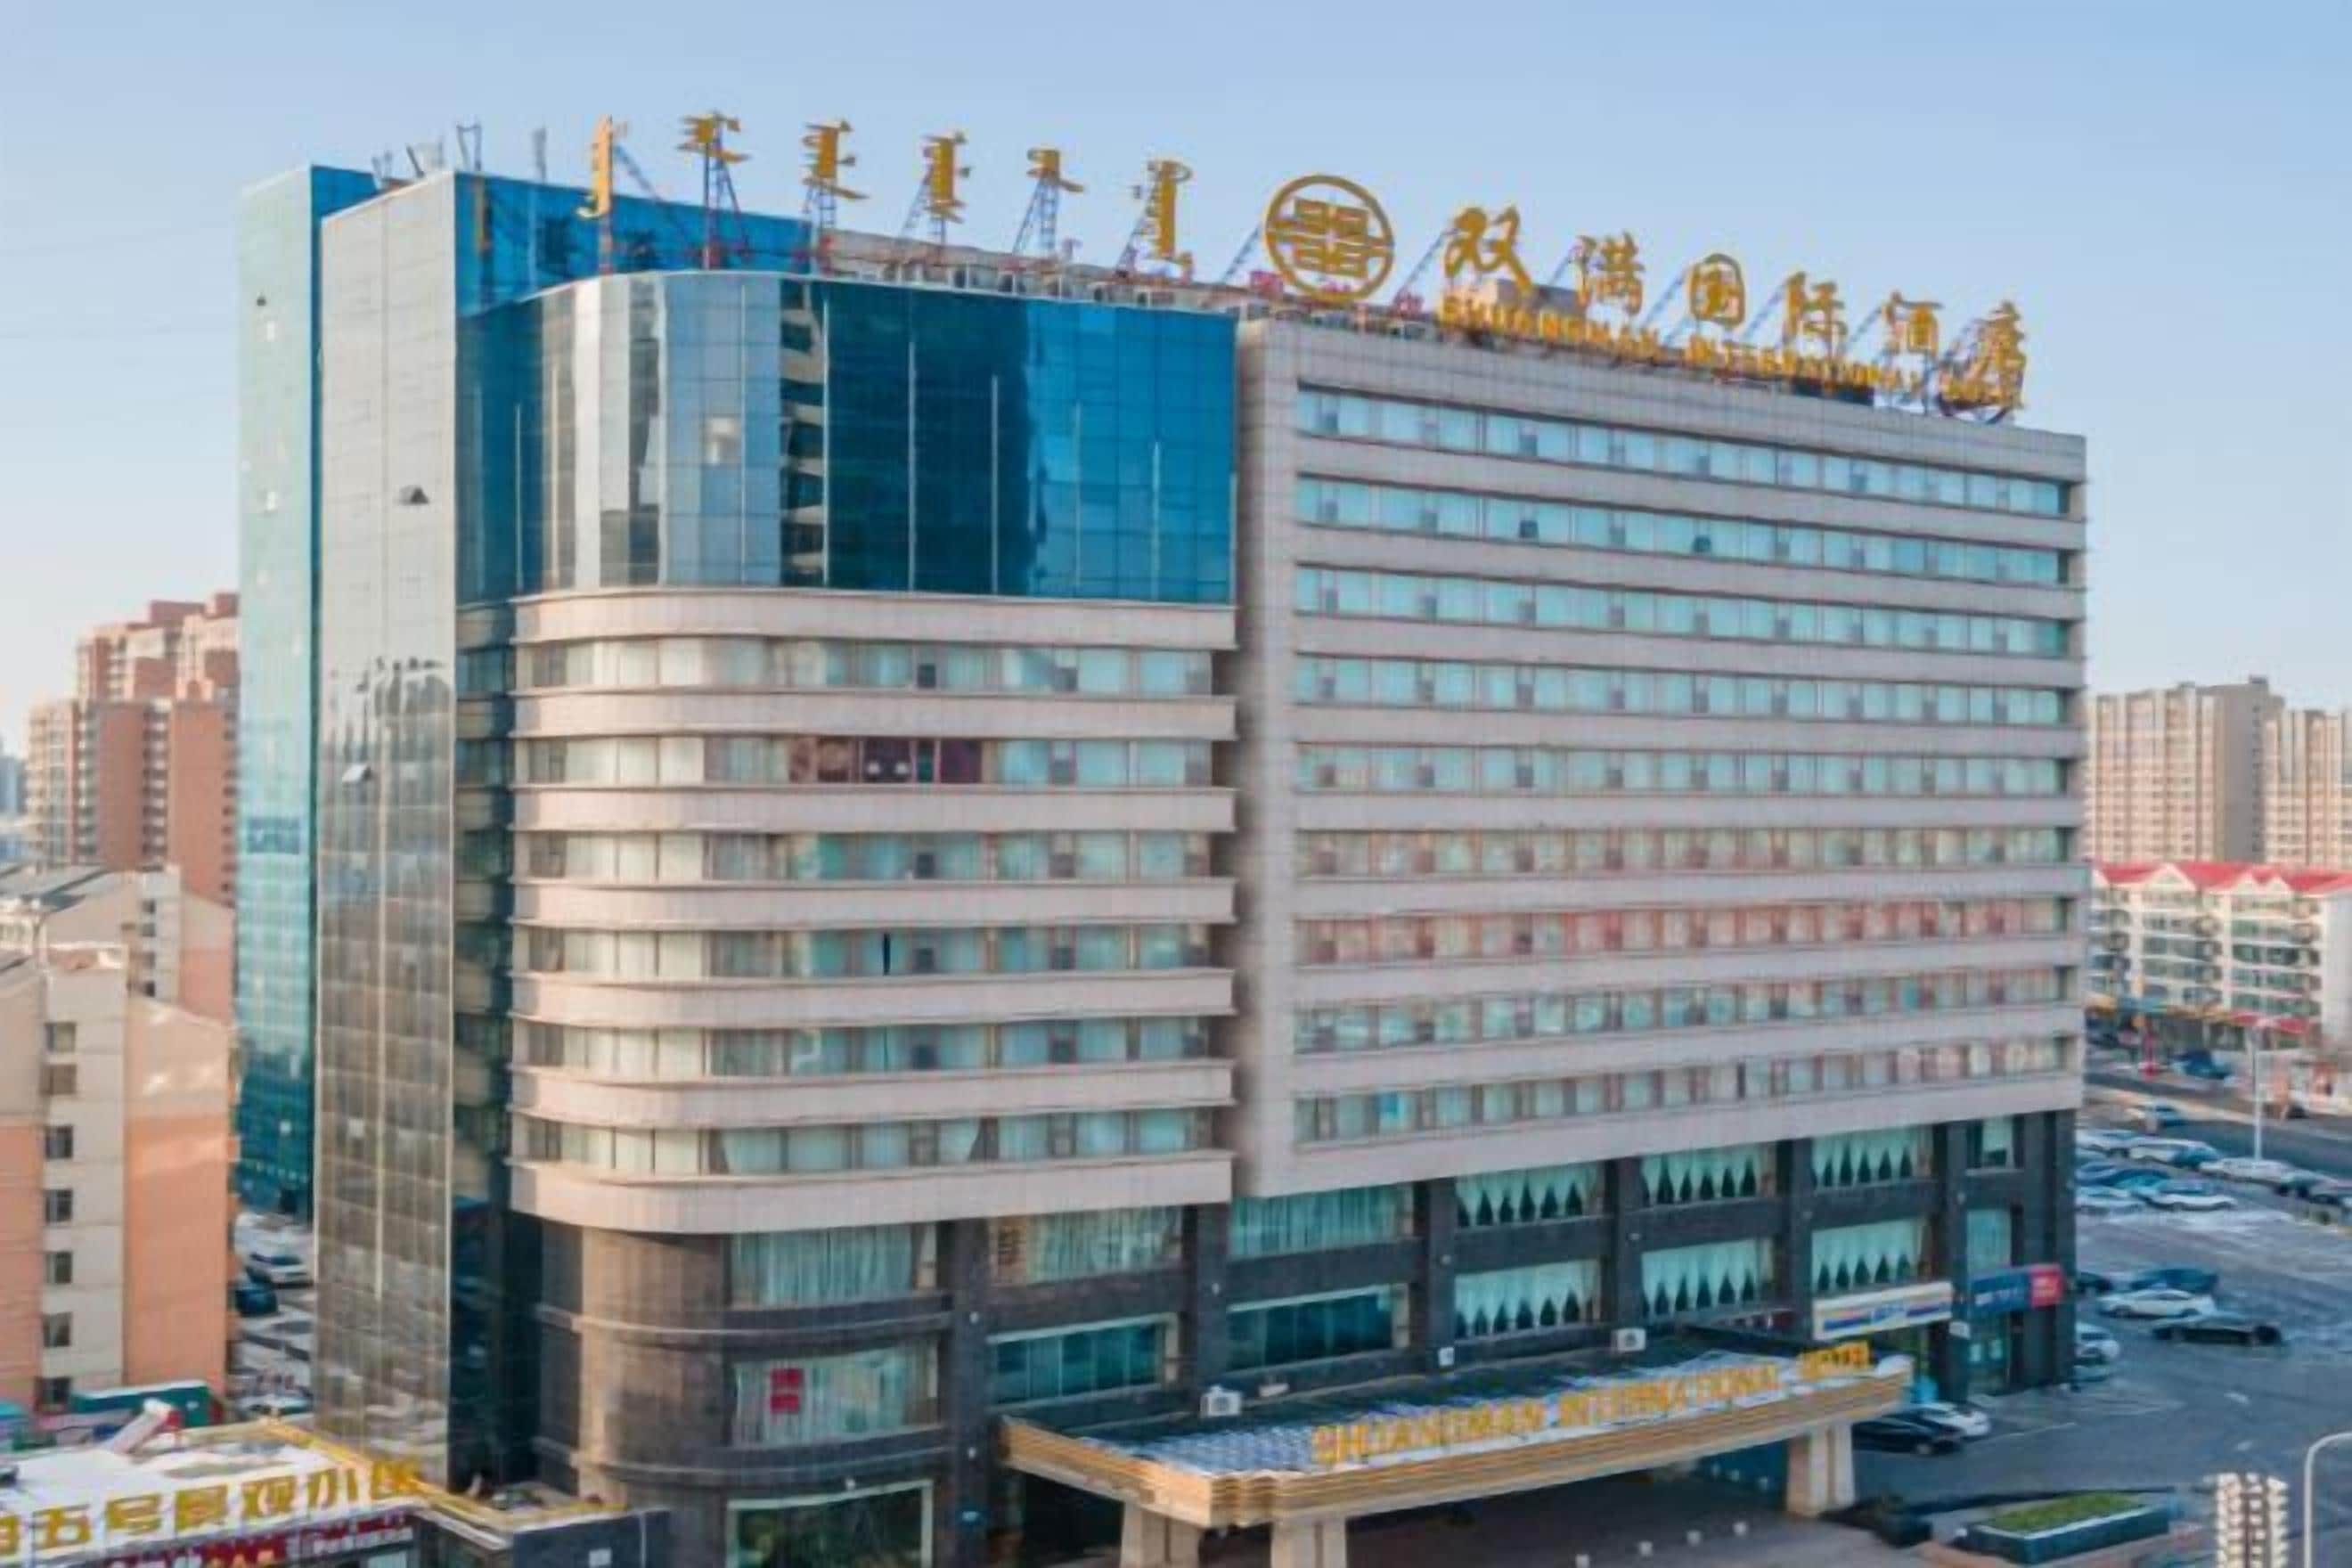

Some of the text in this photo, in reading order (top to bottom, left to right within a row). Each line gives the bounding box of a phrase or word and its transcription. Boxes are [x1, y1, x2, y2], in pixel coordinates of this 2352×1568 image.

[1442, 205, 2026, 410] 双满国际酒店
